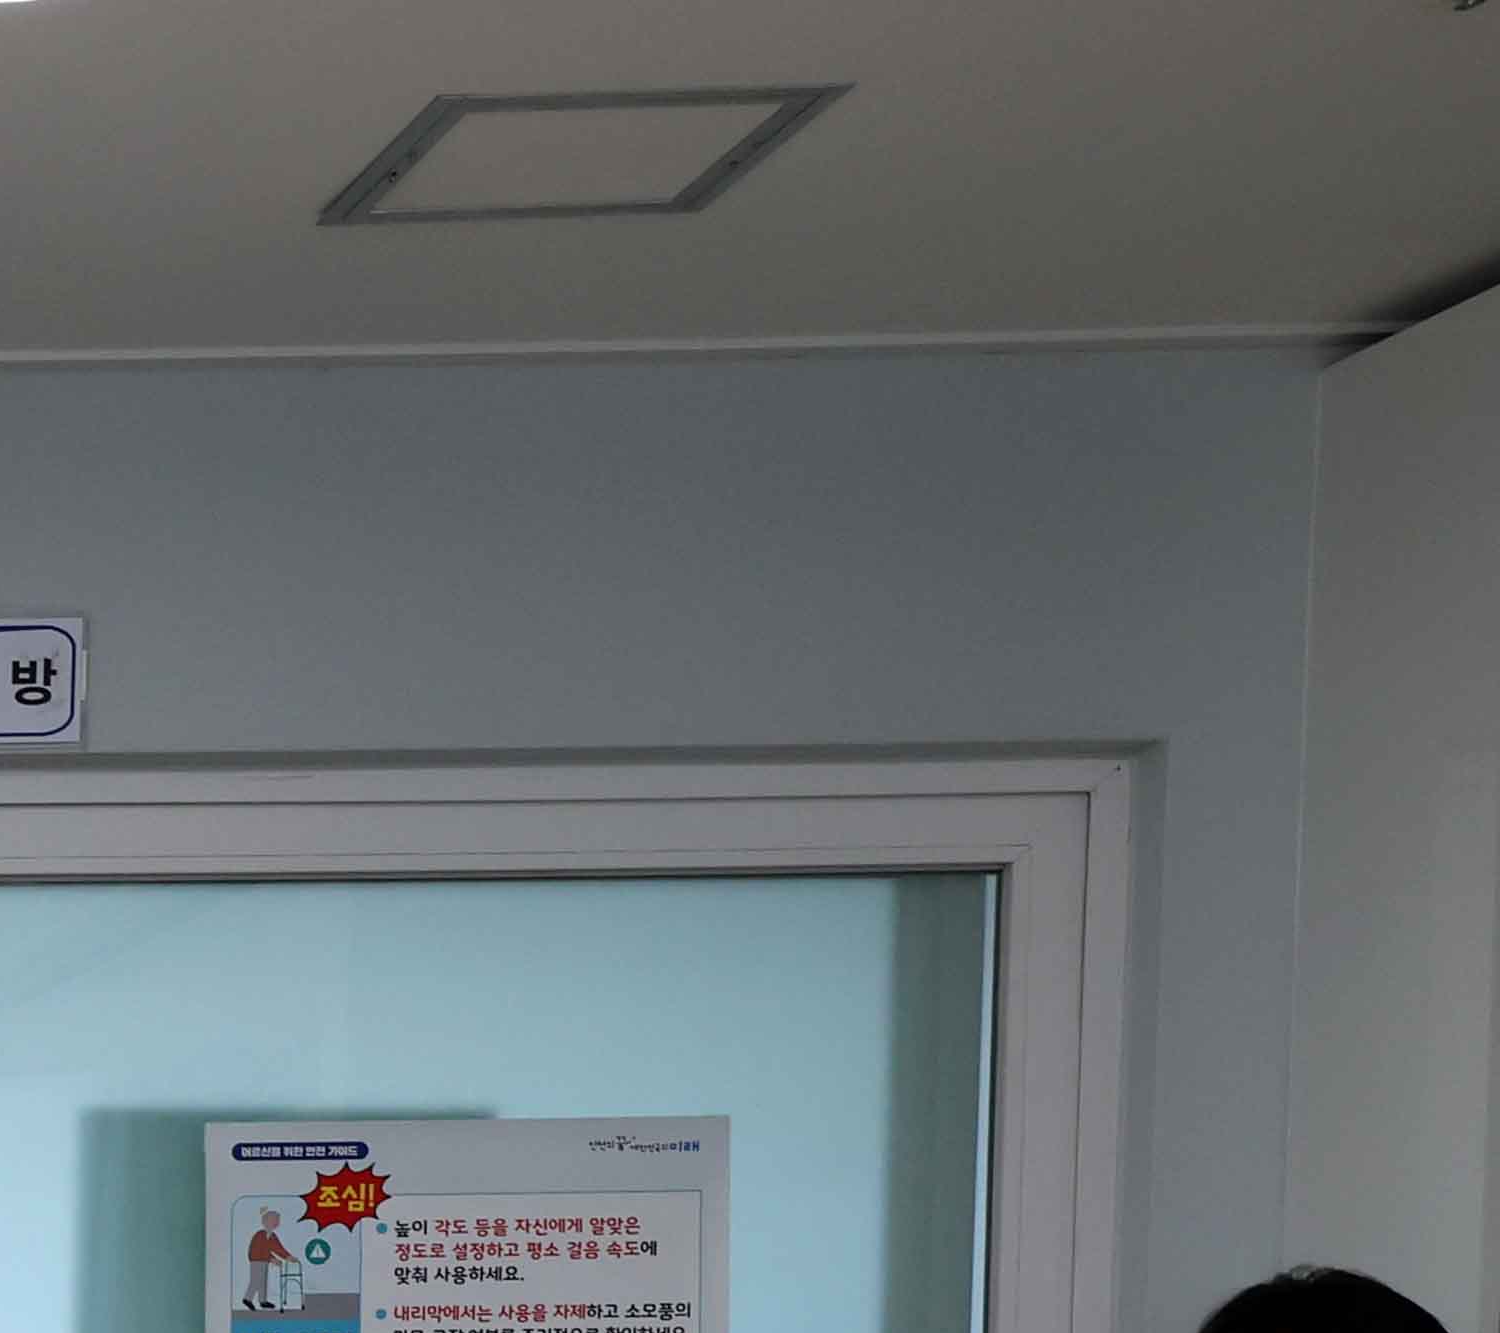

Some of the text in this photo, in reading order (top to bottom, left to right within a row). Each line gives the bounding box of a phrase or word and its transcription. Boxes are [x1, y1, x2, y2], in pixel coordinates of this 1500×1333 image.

[11, 657, 58, 706] 방
[327, 1145, 358, 1157] 가이드
[668, 1139, 700, 1153] 미래
[317, 1183, 375, 1212] 조심!
[394, 1216, 641, 1238] 높이 각도 등을 자신에게 알맞은
[395, 1240, 658, 1261] 정도로 설정하고 평소 걸음 속도에
[394, 1266, 524, 1285] 맞춰 사용하세요.
[393, 1301, 692, 1322] 내리막에서는 사용을 자제하고 소모품의
